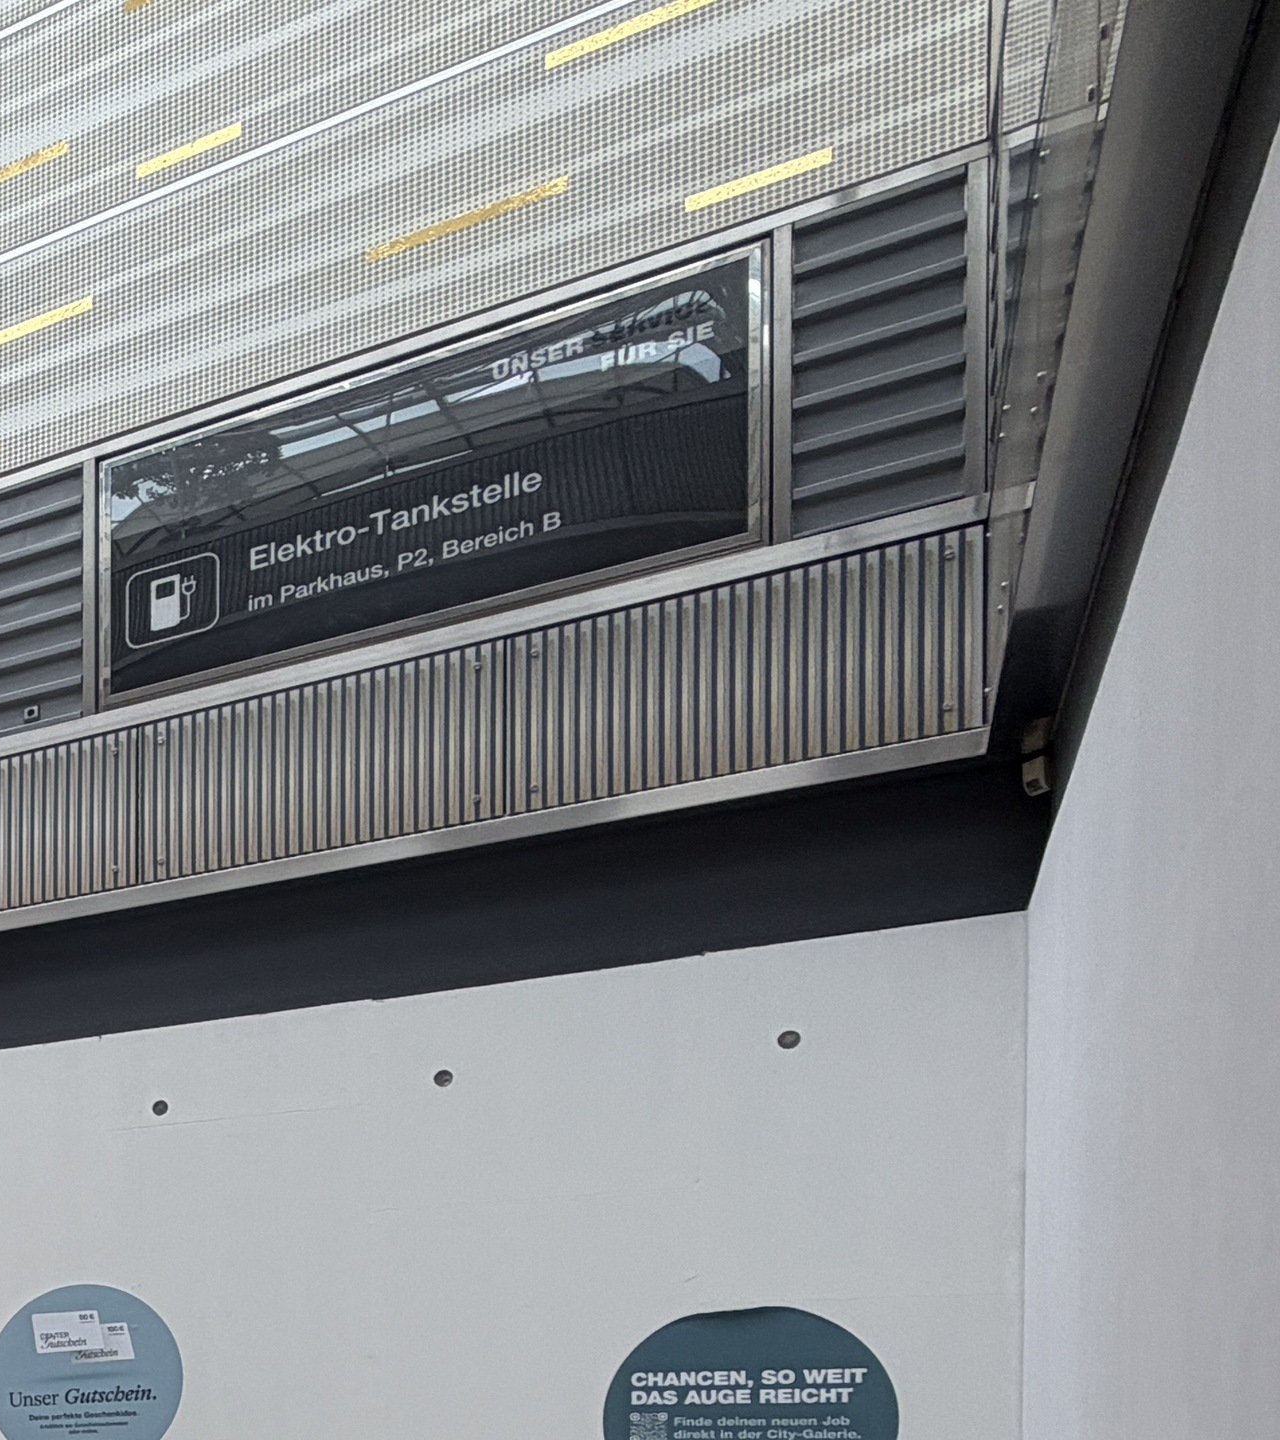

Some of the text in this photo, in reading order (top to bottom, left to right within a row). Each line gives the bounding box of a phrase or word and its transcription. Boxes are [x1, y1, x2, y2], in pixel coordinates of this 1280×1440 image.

[492, 336, 584, 380] UNSER
[600, 320, 715, 372] FÜR SIE
[248, 470, 543, 571] Elektro-Tankstelle
[247, 510, 562, 612] im Parkhaus, P2, Bereich B
[630, 1367, 868, 1388] CHANCEN, SO WEIT
[8, 1384, 158, 1408] Unser Gutschein.
[630, 1387, 854, 1406] DAS AUGE REICHT
[673, 1415, 851, 1427] Finde deinen neuen Job
[673, 1429, 716, 1440] direkt
[719, 1429, 734, 1440] in
[737, 1429, 763, 1440] der
